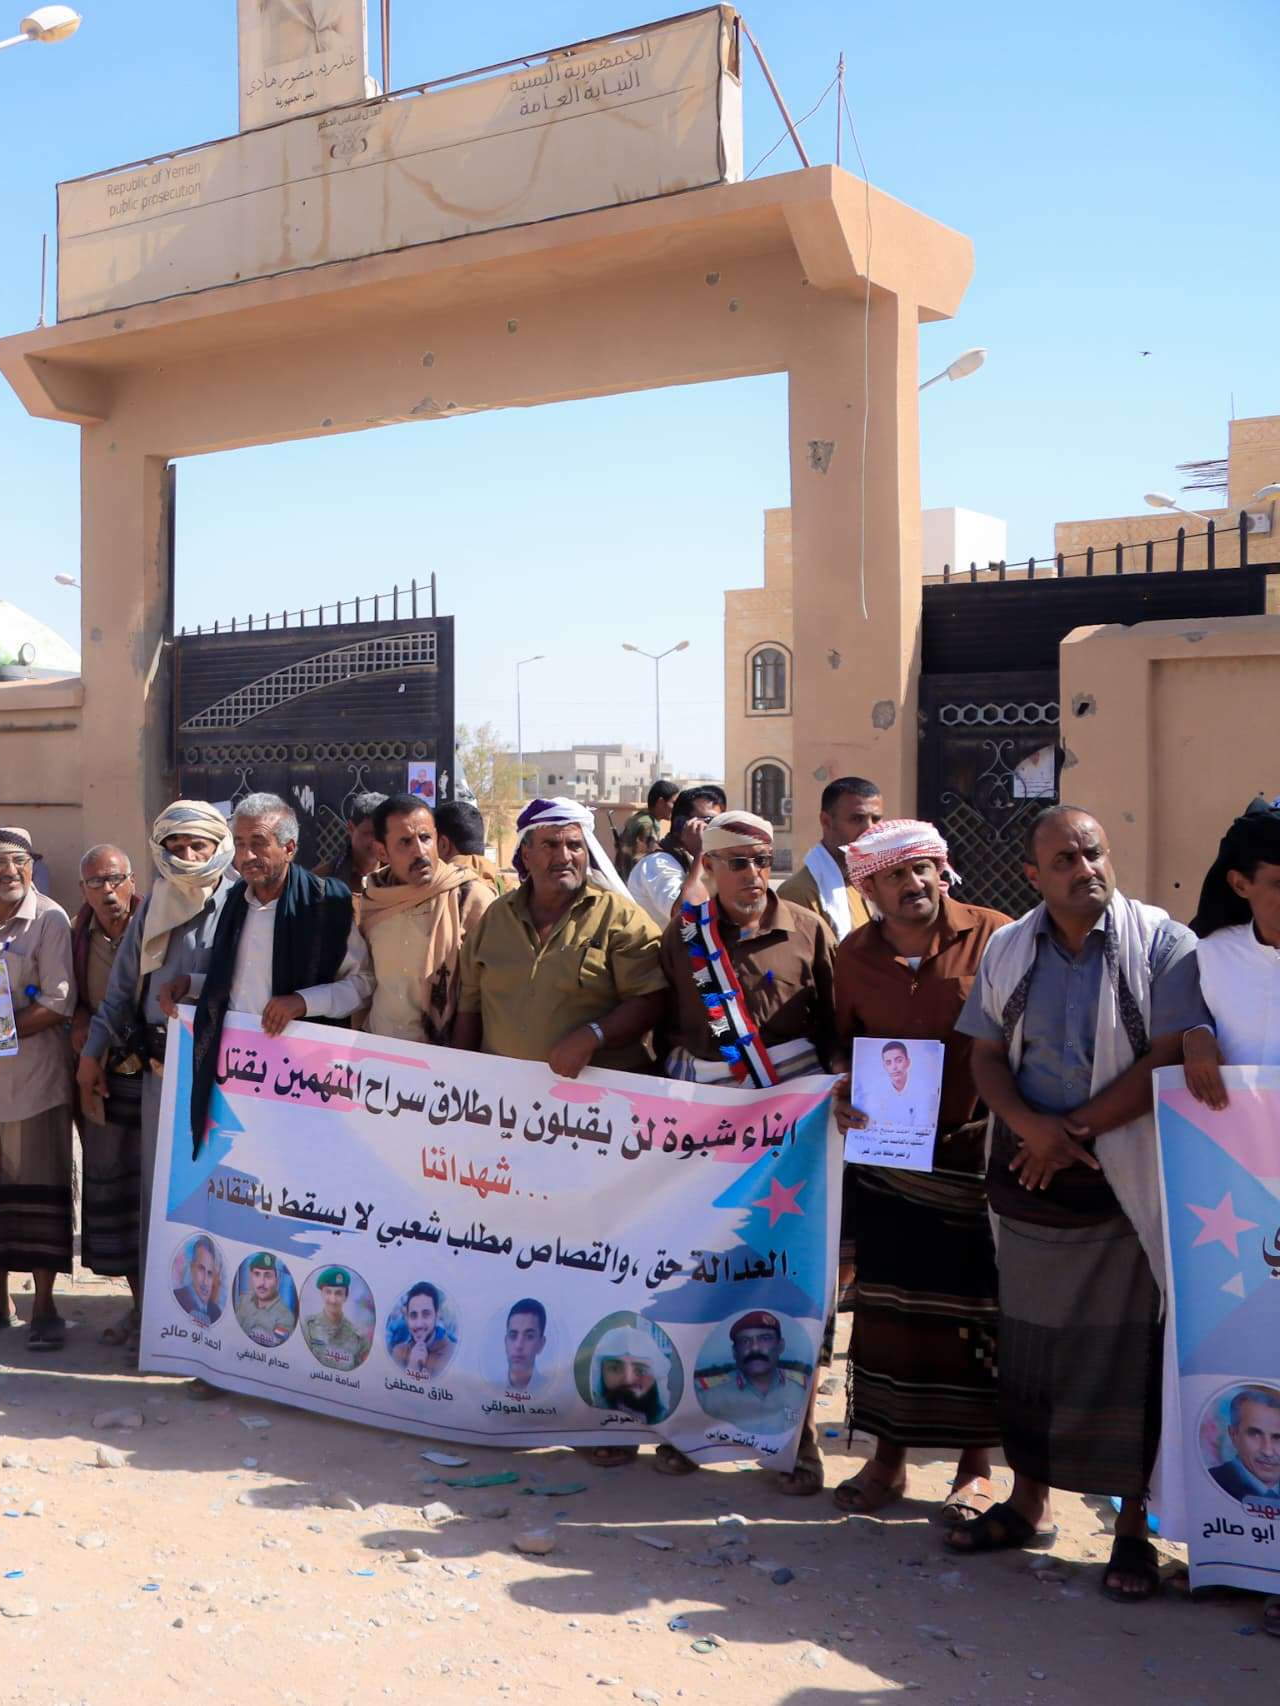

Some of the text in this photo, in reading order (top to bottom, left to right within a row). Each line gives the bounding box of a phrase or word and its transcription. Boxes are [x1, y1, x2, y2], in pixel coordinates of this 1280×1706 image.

[510, 38, 652, 93] الجمهورية اليمنية
[519, 69, 641, 116] النيابة العامة
[106, 162, 201, 198] Republic of Yemen
[142, 181, 201, 210] prosecution
[216, 1047, 268, 1094] بقتل
[273, 1056, 362, 1104] المتهمين
[365, 1076, 426, 1118] سراح
[523, 1100, 613, 1156] يقبلون
[620, 1113, 657, 1160] لن
[661, 1116, 737, 1160] شبوة
[741, 1111, 798, 1159] ابناء
[207, 1175, 273, 1219] بالتقادم
[278, 1186, 348, 1236] يسقط
[355, 1200, 375, 1231] لا
[376, 1208, 443, 1248] شعبي
[446, 1221, 513, 1257] مطلب
[160, 1323, 189, 1339] صالح
[1202, 1516, 1276, 1545] ابو صالح
